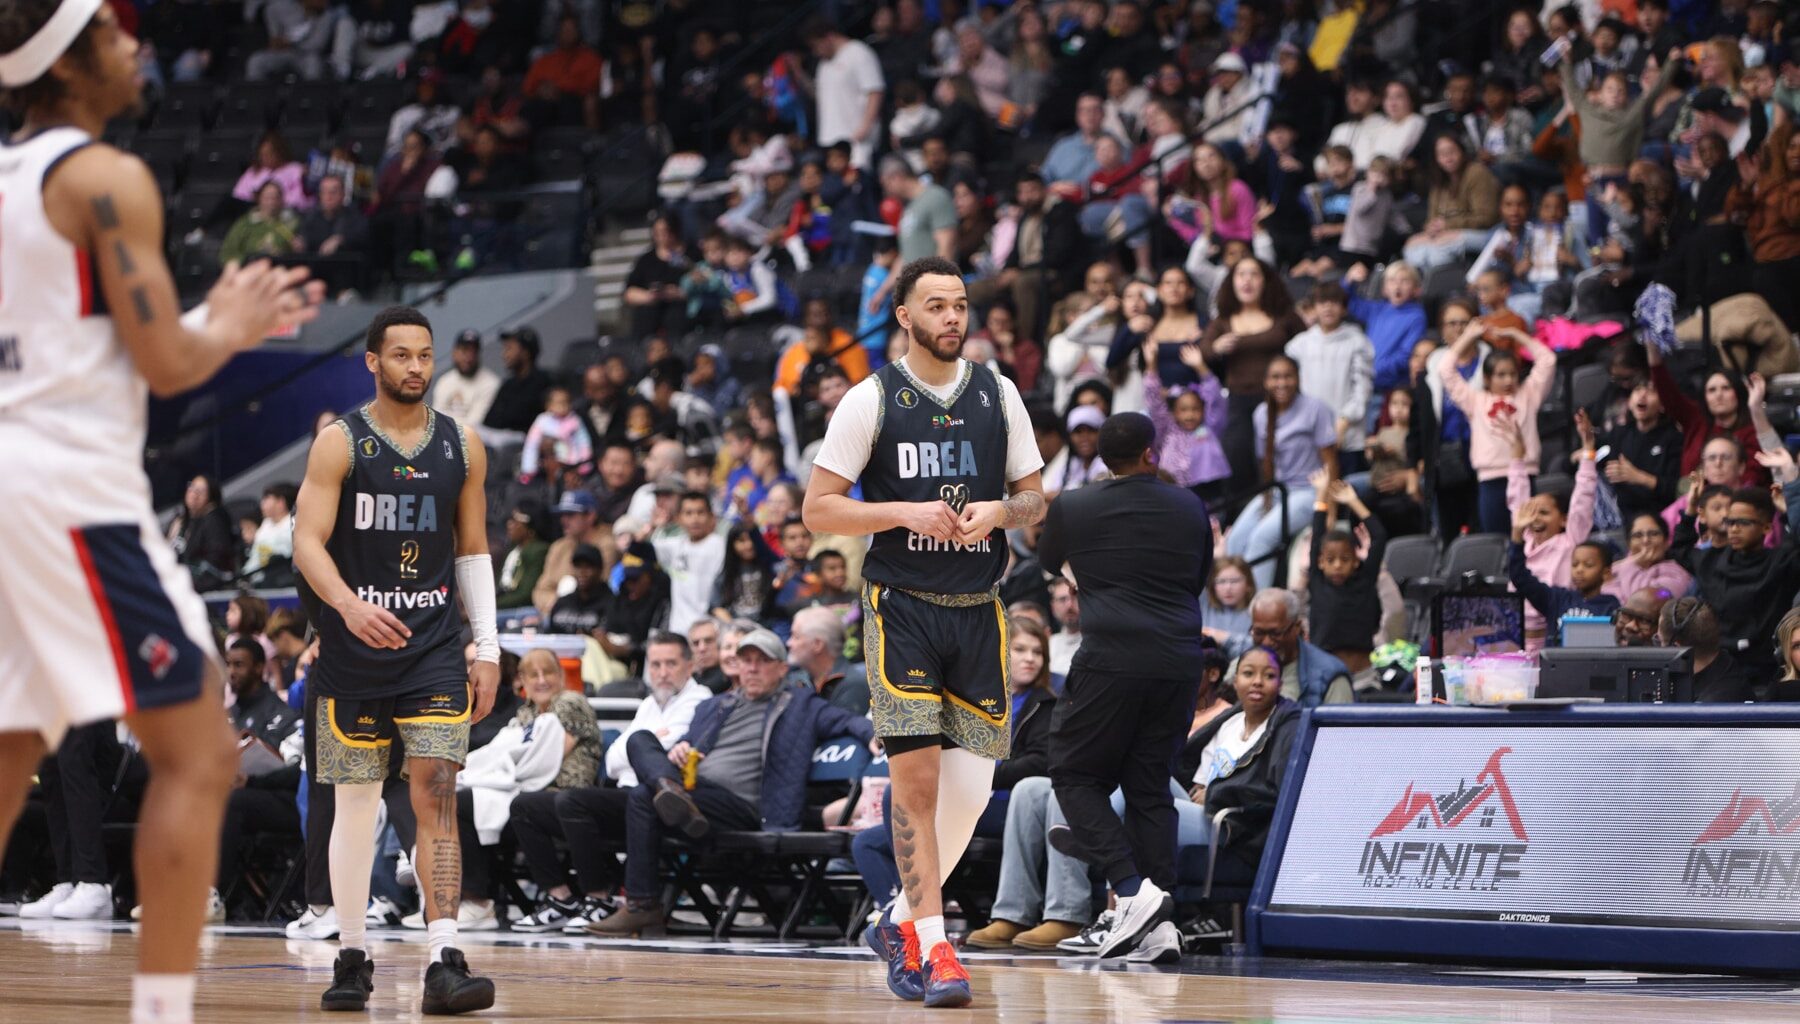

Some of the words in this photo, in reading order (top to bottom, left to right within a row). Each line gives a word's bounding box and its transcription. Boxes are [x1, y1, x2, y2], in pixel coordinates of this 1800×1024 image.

[897, 441, 978, 479] DREA
[354, 492, 438, 532] DREA
[400, 540, 419, 579] 2
[1358, 841, 1528, 881] INFINITE
[1499, 913, 1551, 923] DAKTRONICS
